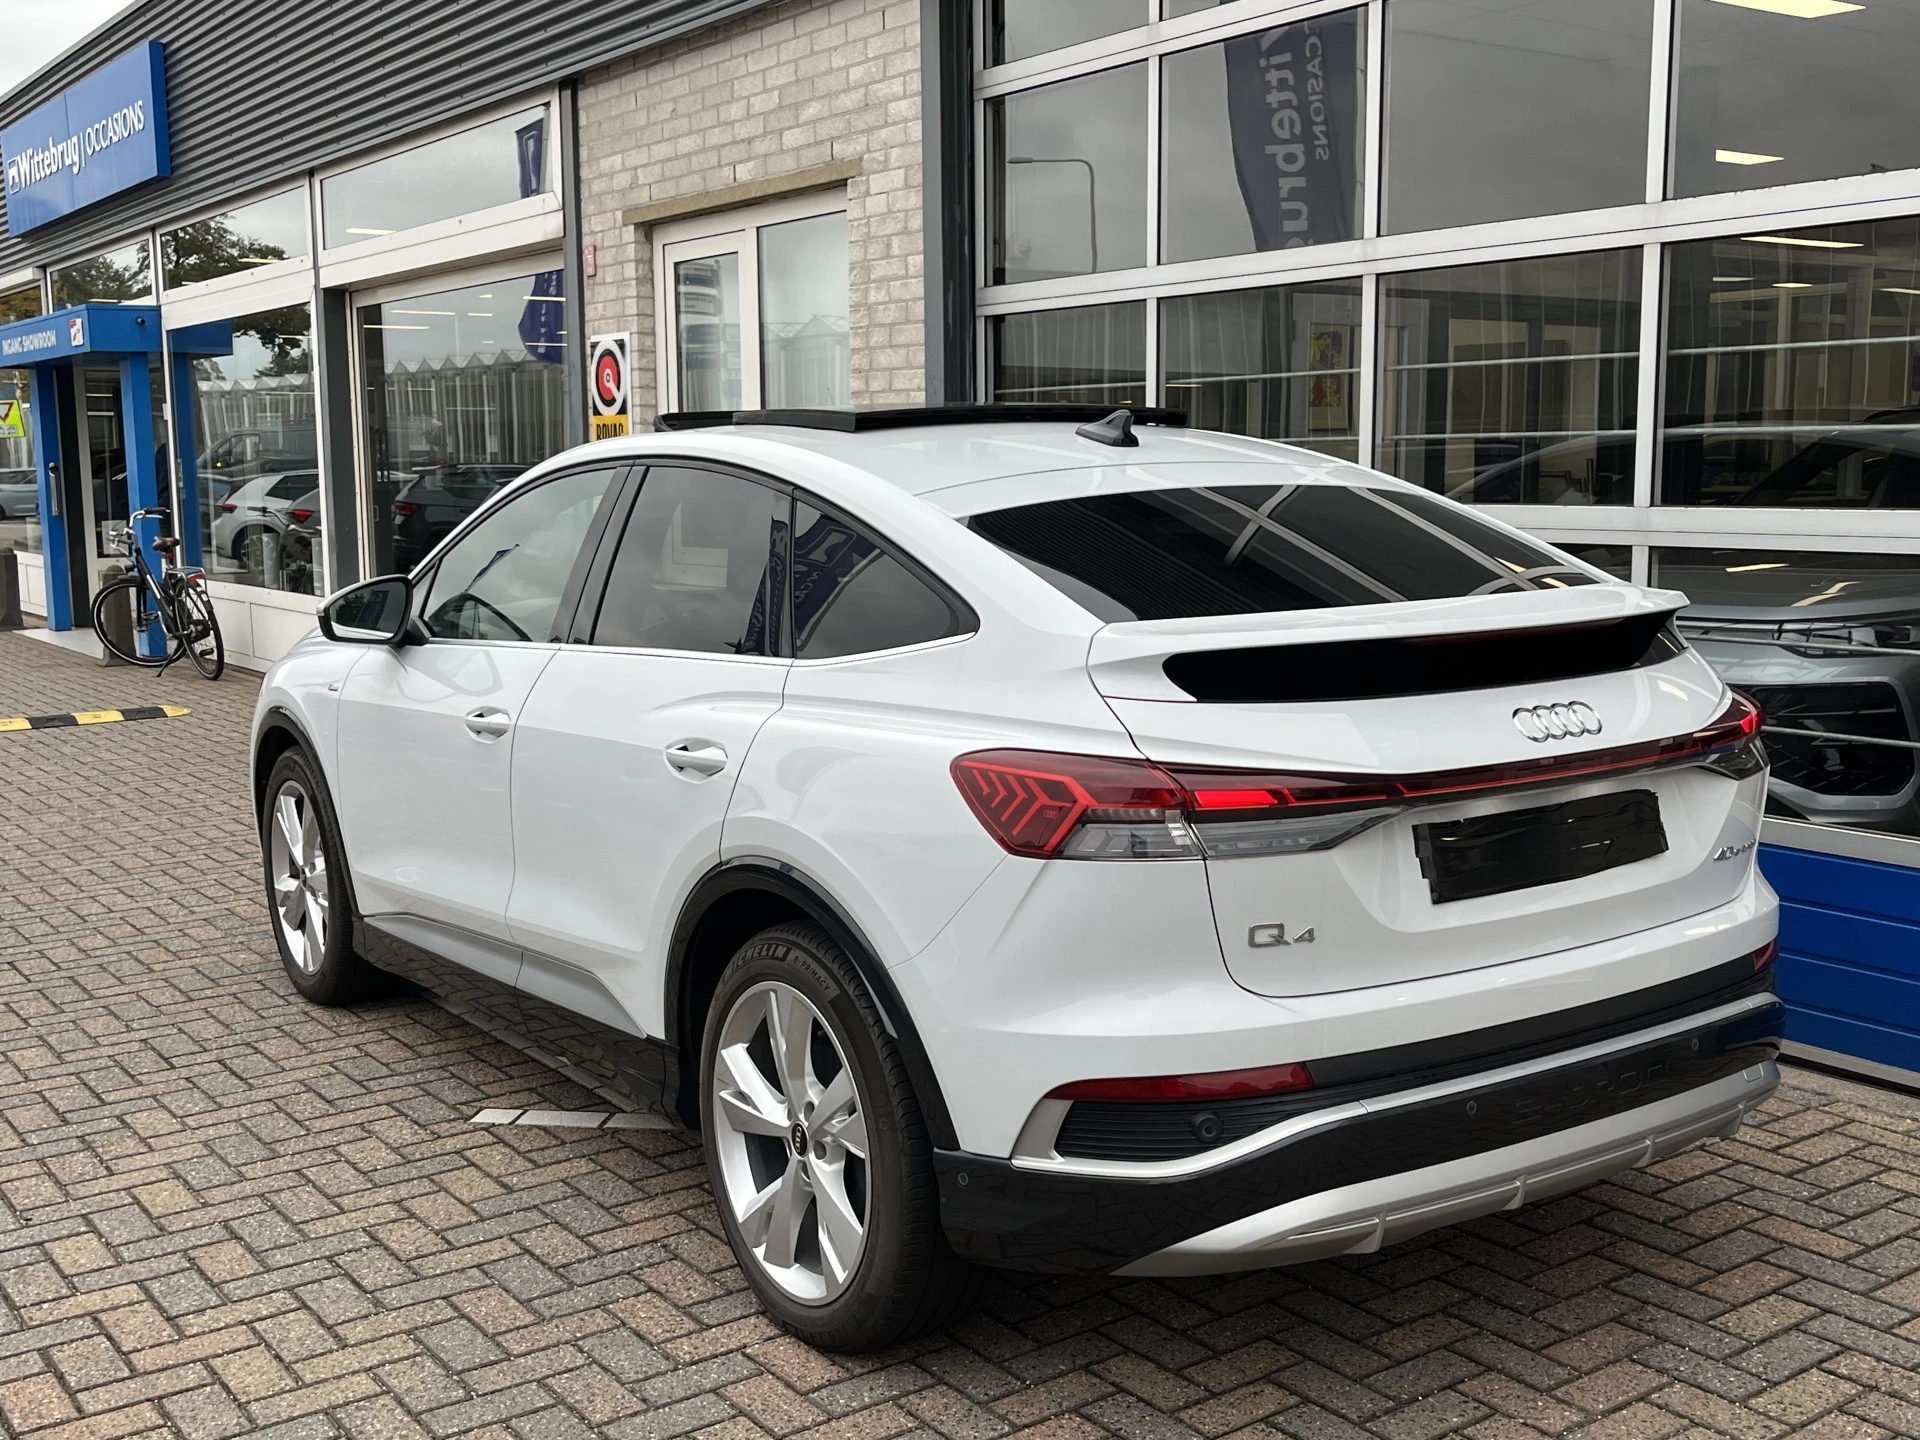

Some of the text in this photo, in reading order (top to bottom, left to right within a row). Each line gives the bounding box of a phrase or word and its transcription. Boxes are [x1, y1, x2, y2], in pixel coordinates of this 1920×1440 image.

[17, 100, 145, 188] Wittebrug OCCASIONS
[22, 329, 57, 352] SHOWROOM
[1247, 921, 1316, 948] Q4
[724, 943, 788, 982] MICHELIN
